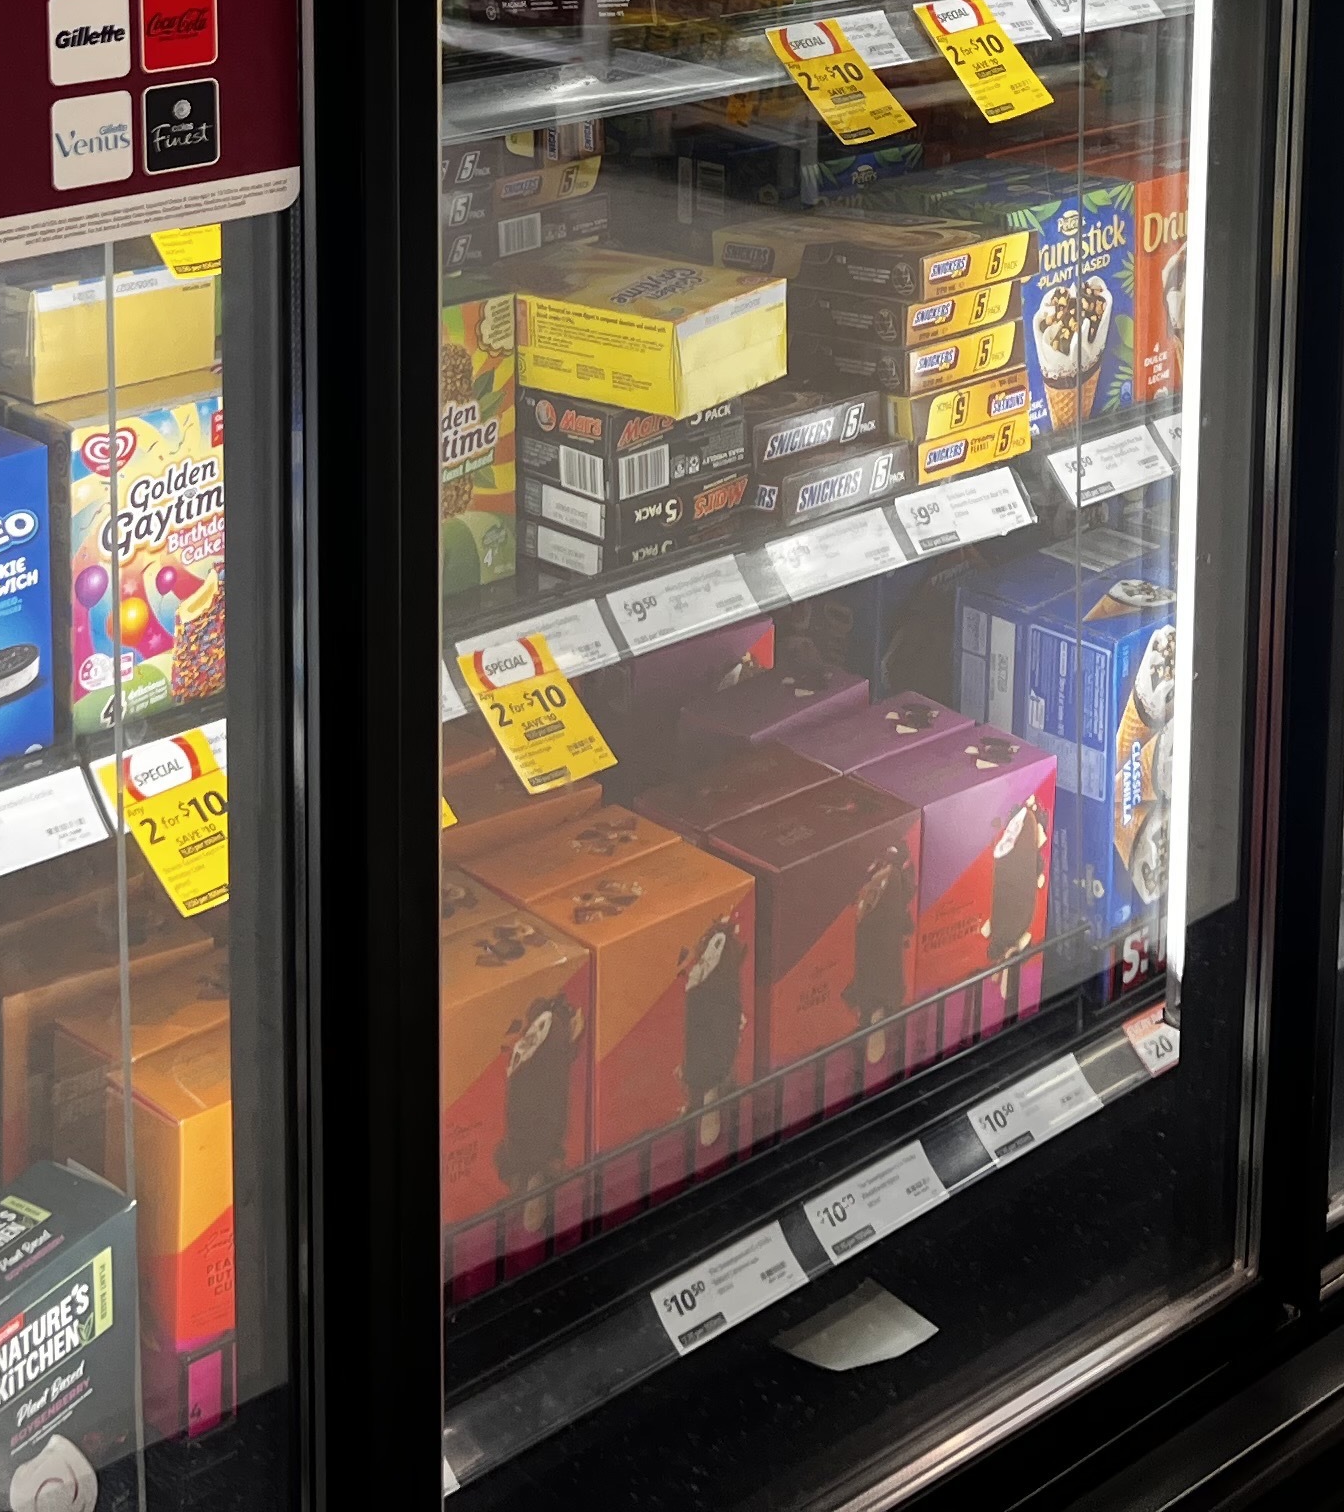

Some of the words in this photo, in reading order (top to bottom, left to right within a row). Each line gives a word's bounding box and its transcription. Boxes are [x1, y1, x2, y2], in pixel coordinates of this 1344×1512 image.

[936, 5, 971, 24] SPECIAL
[55, 24, 127, 50] Gillette
[55, 129, 133, 160] Venus
[151, 122, 215, 154] Finest
[762, 416, 834, 461] SNICKERS
[129, 458, 218, 511] Golden
[485, 652, 527, 676] SPECIAL
[489, 701, 510, 728] 2
[524, 683, 568, 711] $10
[133, 758, 184, 788] SPECIAL
[139, 817, 163, 845] 2
[181, 790, 226, 825] $10
